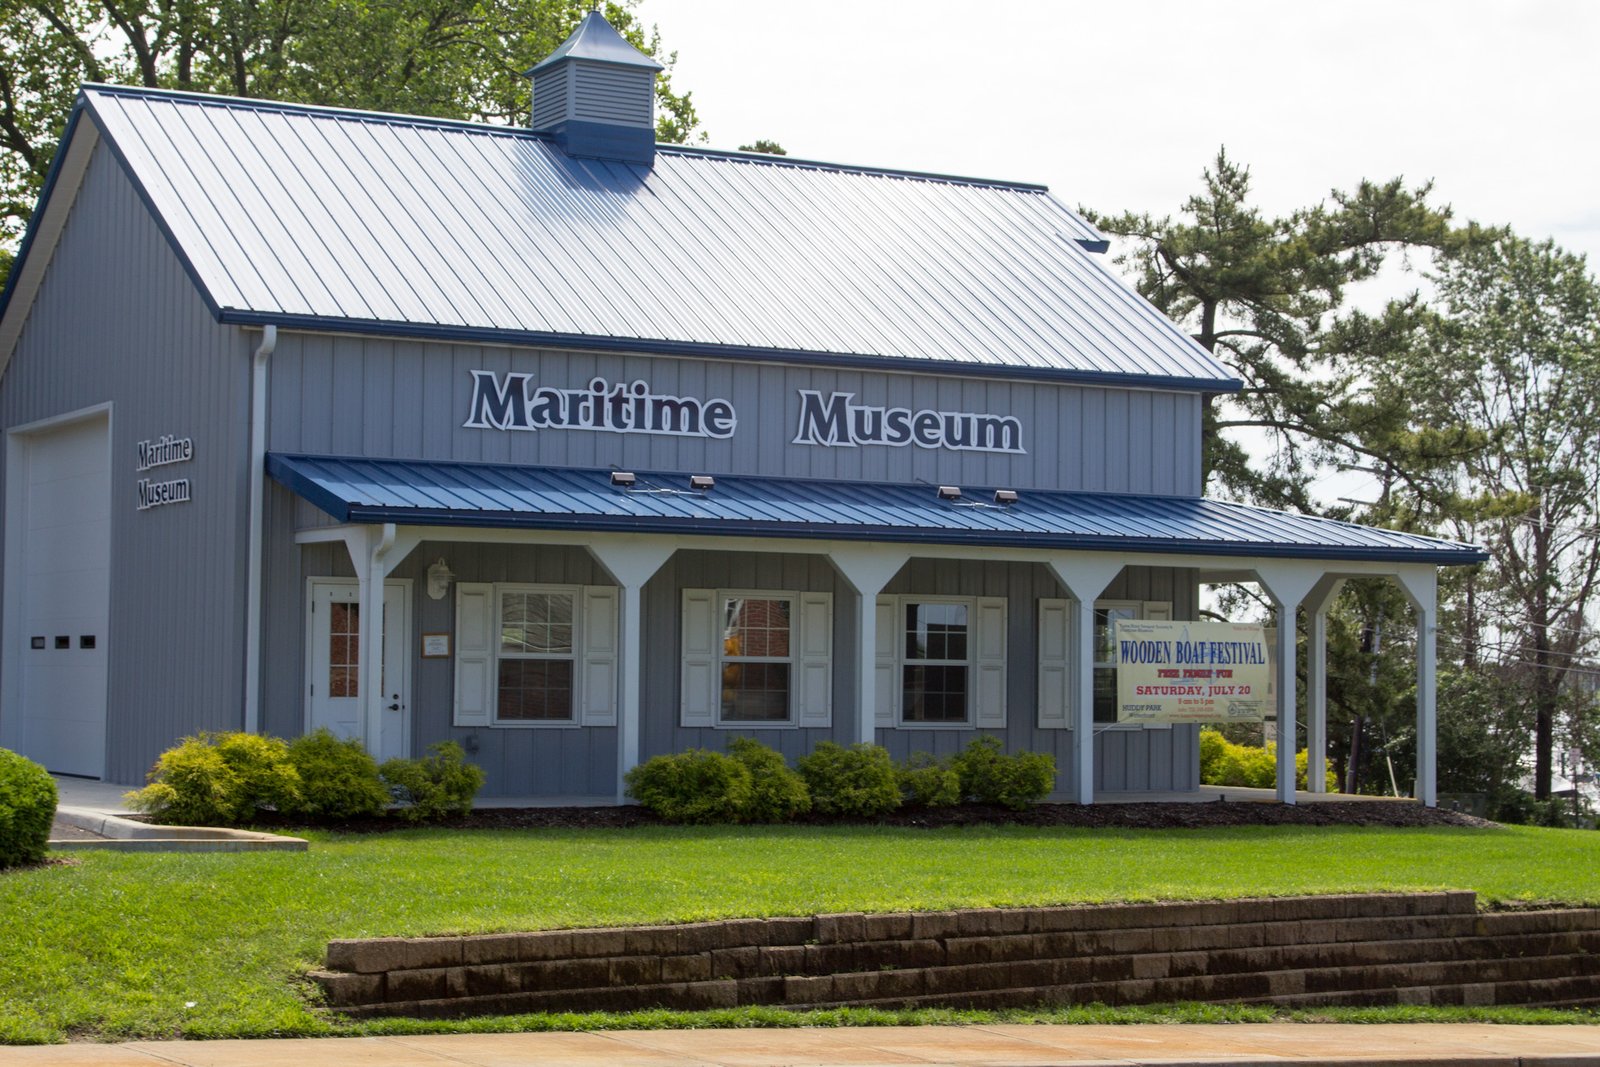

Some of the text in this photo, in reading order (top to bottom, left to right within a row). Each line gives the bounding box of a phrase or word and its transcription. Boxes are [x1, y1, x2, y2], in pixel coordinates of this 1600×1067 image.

[462, 369, 1028, 454] Maritime Museum
[136, 434, 193, 472] Maritime
[136, 478, 191, 510] Museum
[1120, 640, 1265, 665] WOODEN BOAT FESTIVAL
[1216, 669, 1233, 678] FUN
[1136, 685, 1250, 697] SATURDAY, JULY 20
